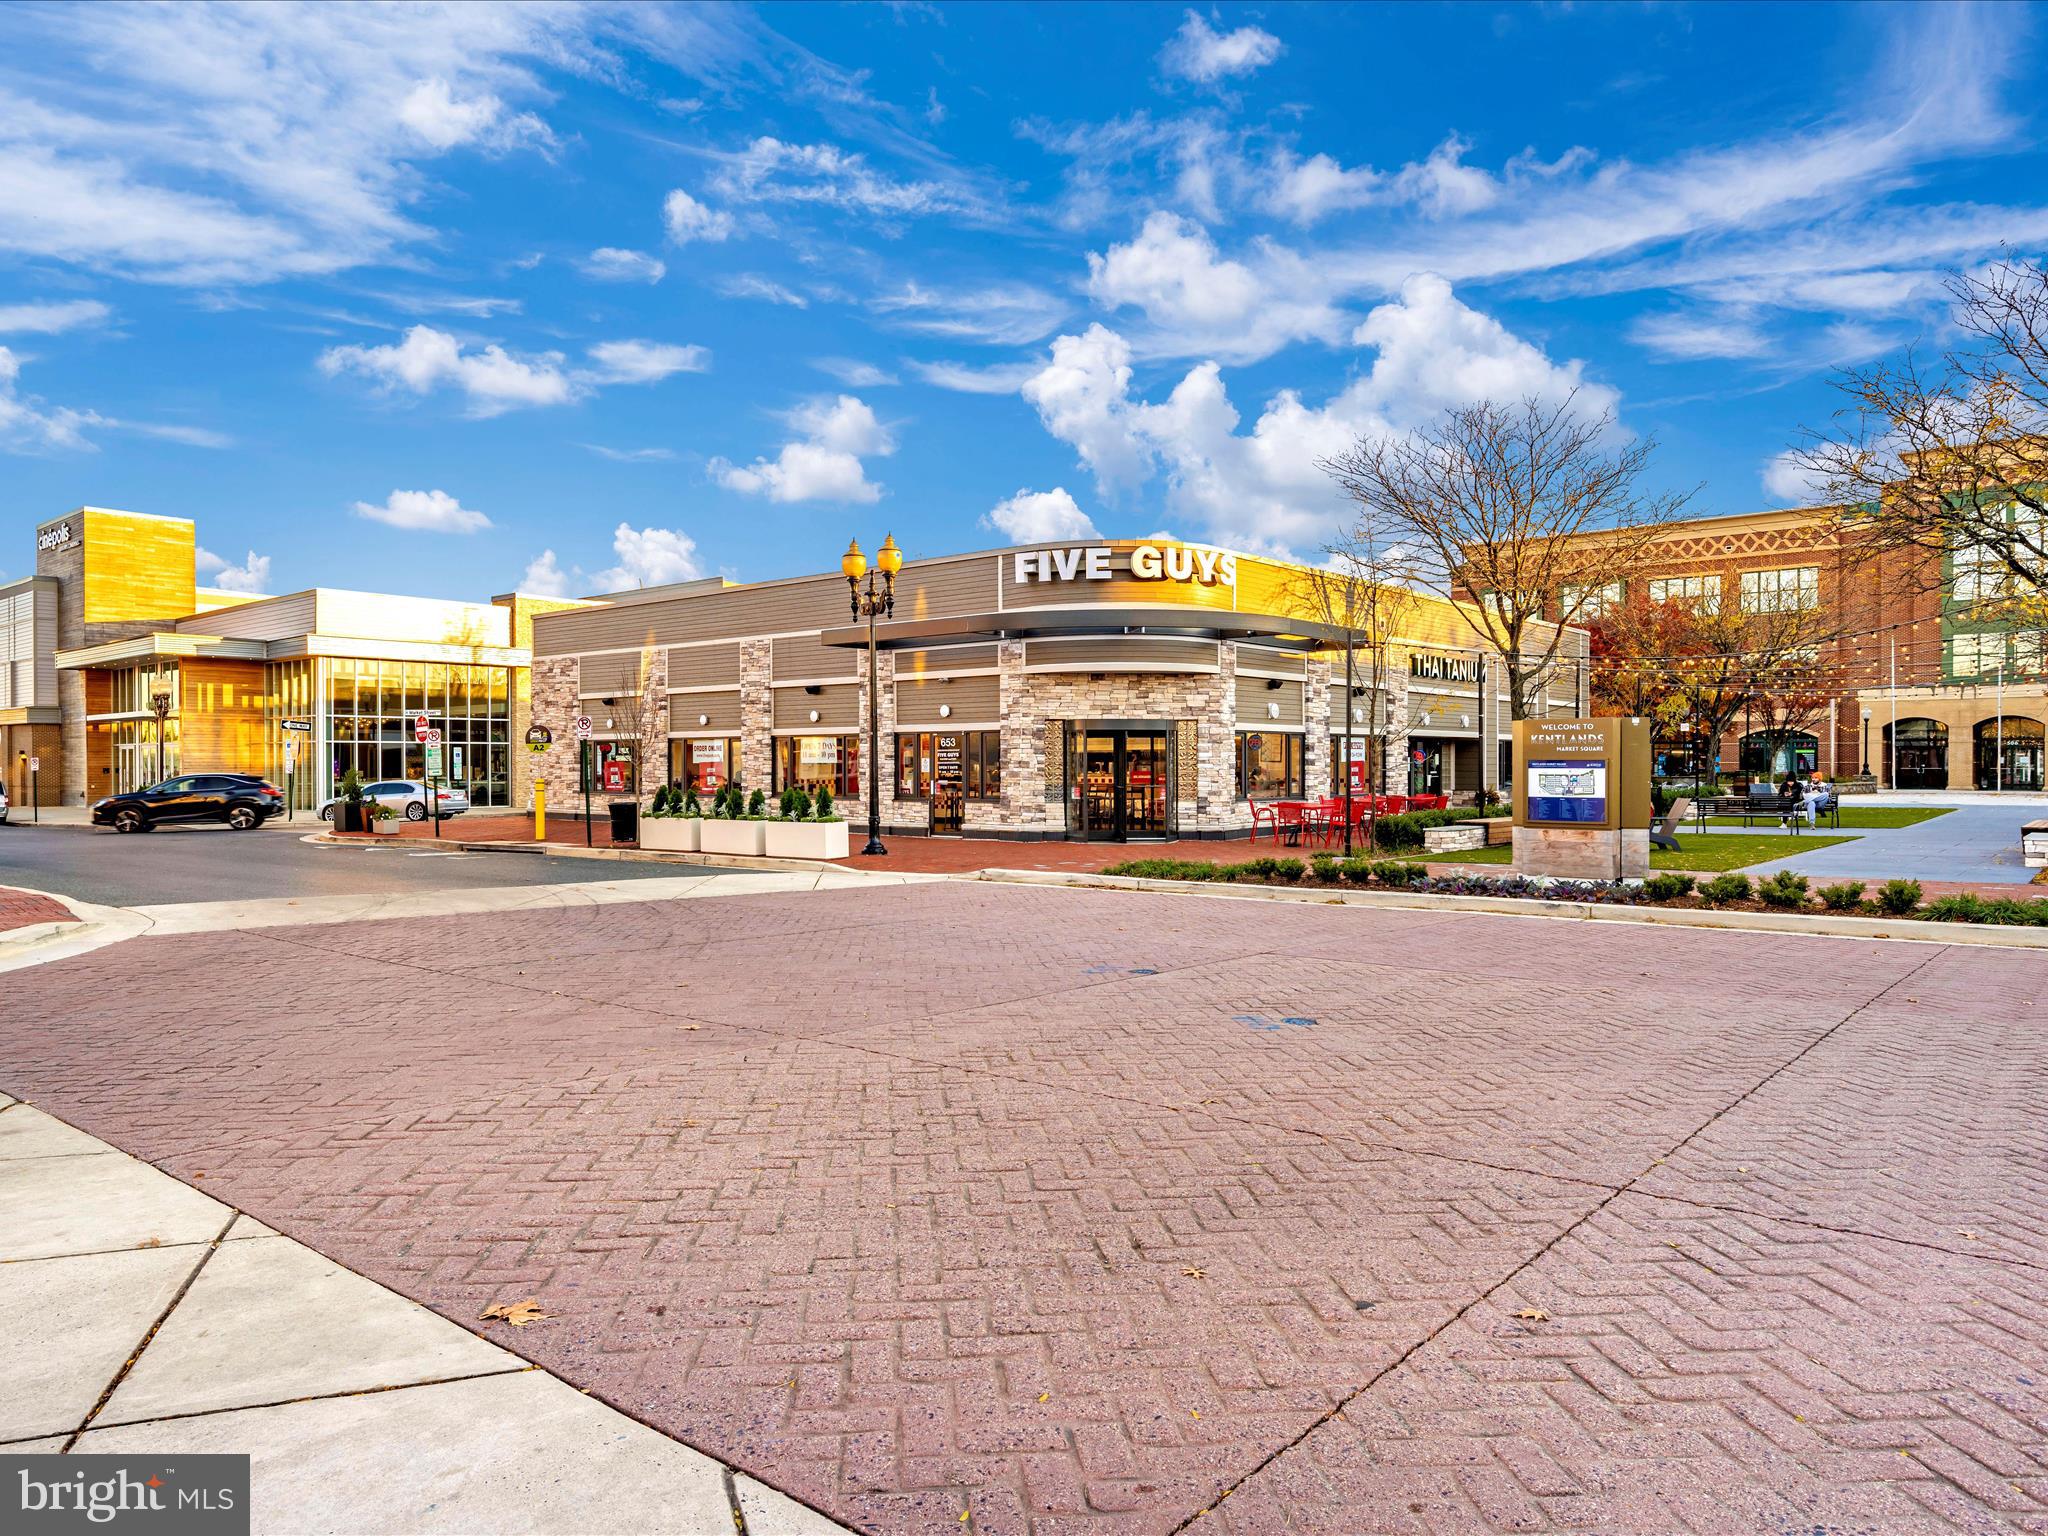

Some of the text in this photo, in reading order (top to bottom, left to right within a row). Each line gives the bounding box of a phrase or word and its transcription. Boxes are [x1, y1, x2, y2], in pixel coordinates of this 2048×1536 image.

[1015, 546, 1236, 586] FIVE GUYS
[940, 737, 956, 747] 653
[1530, 734, 1605, 744] KENTLANDS
